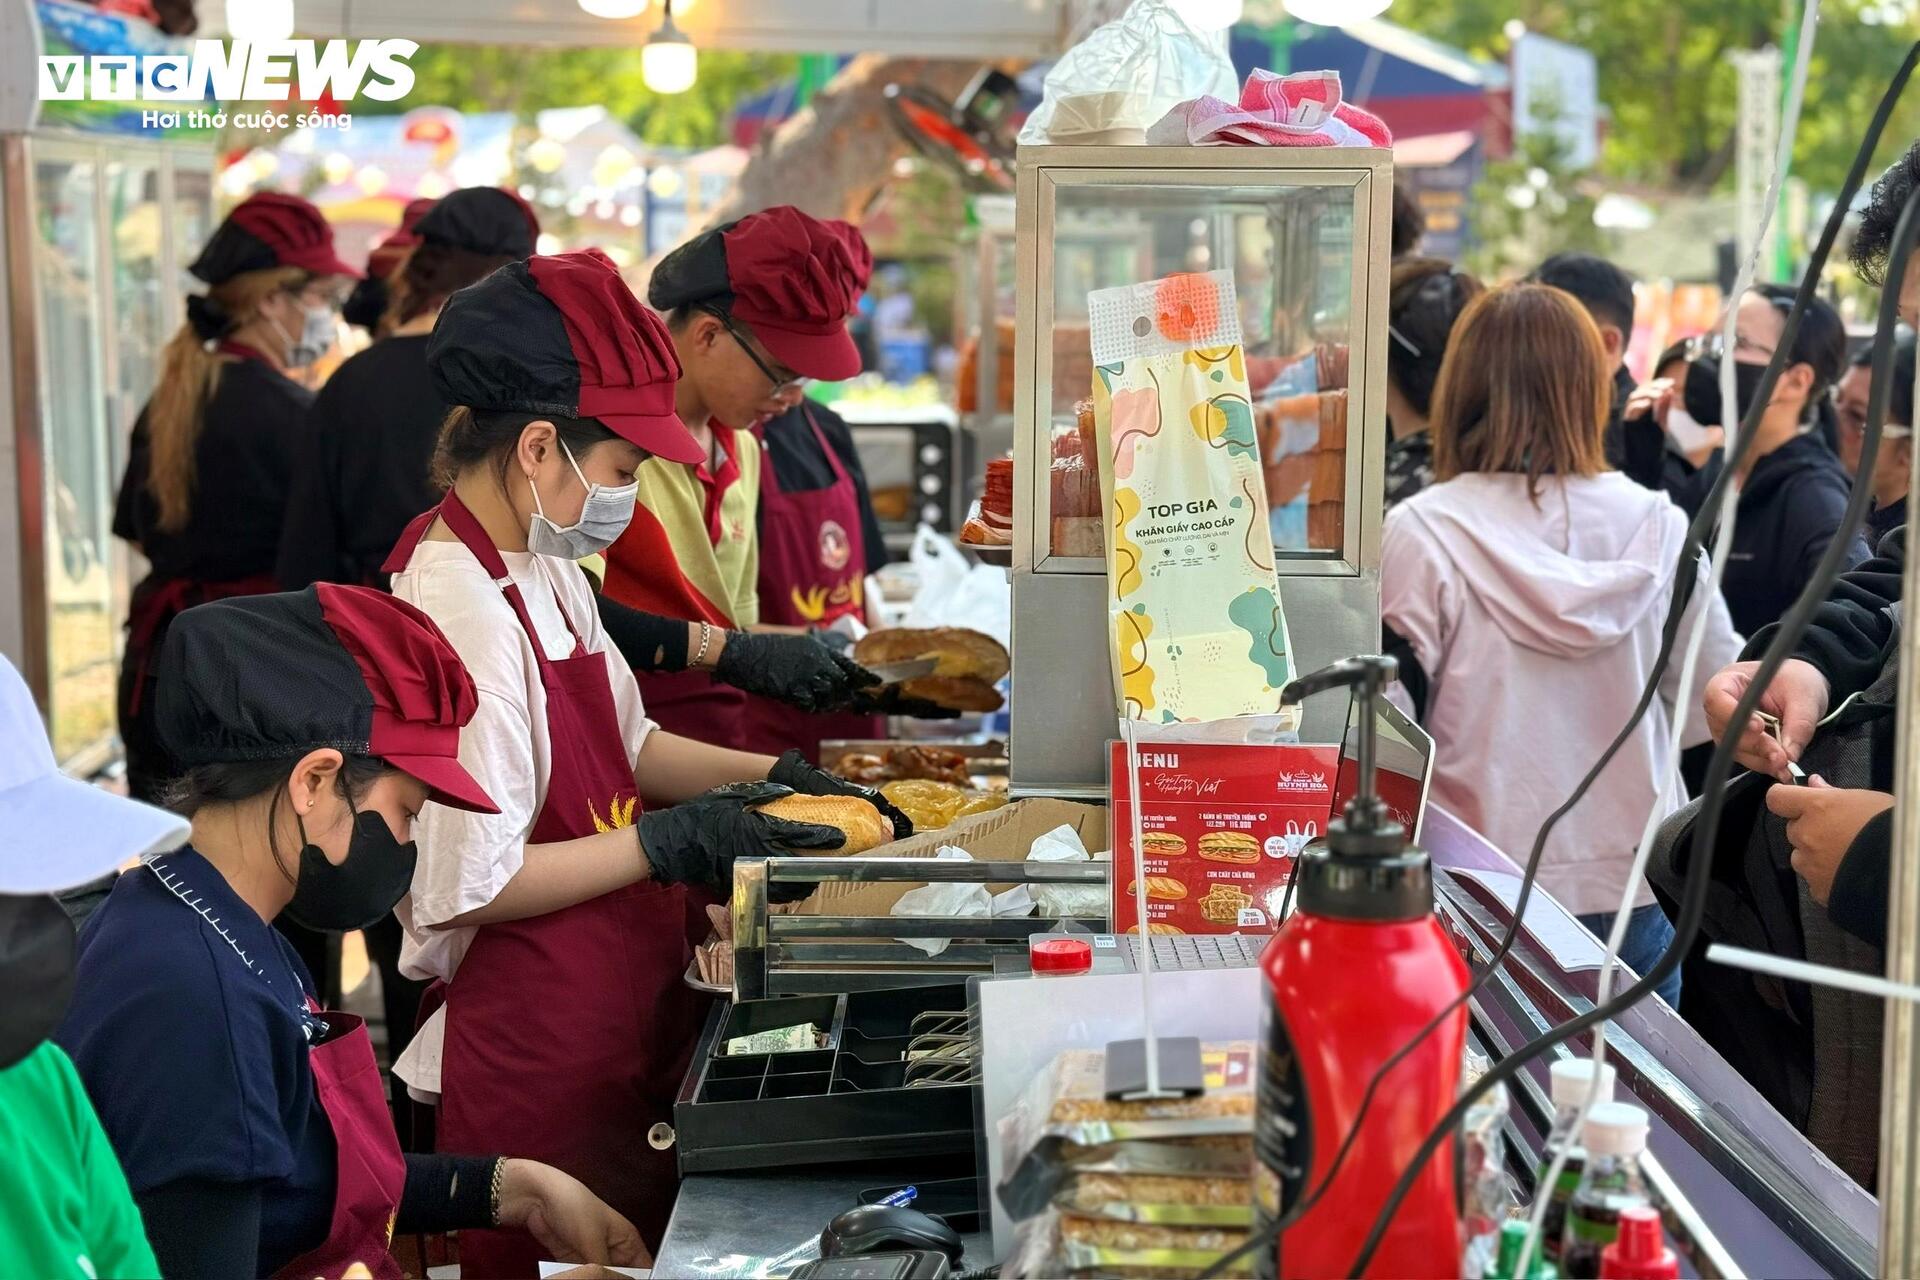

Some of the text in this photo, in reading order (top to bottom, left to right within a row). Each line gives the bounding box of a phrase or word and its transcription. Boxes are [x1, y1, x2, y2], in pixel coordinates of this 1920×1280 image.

[1148, 499, 1218, 519] TOP GIA
[1136, 515, 1235, 538] KHĂN GIẤY CAO CẤP
[1137, 753, 1179, 768] ENU
